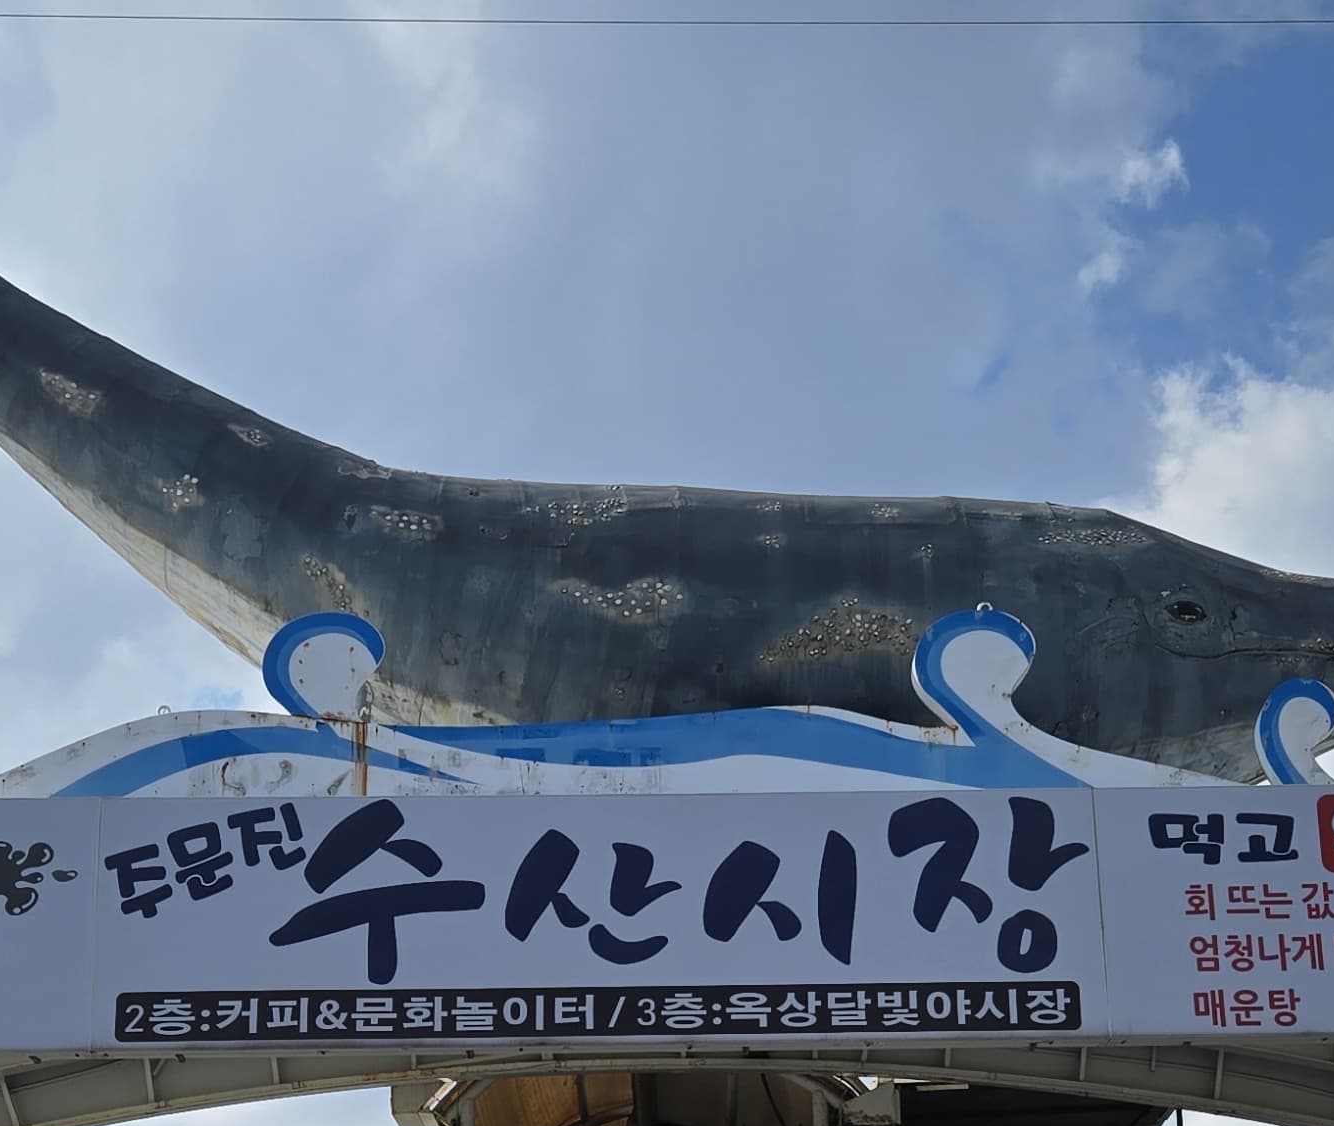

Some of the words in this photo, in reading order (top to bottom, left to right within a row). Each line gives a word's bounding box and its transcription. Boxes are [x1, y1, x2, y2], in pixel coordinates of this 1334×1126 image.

[104, 801, 307, 920] 주문진
[1148, 812, 1300, 866] 먹고
[268, 796, 1090, 985] 수산시장
[1185, 883, 1216, 921] 회
[1226, 882, 1297, 919] 뜨는
[1189, 931, 1325, 974] 엄청나게
[1193, 988, 1301, 1029] 매운탕
